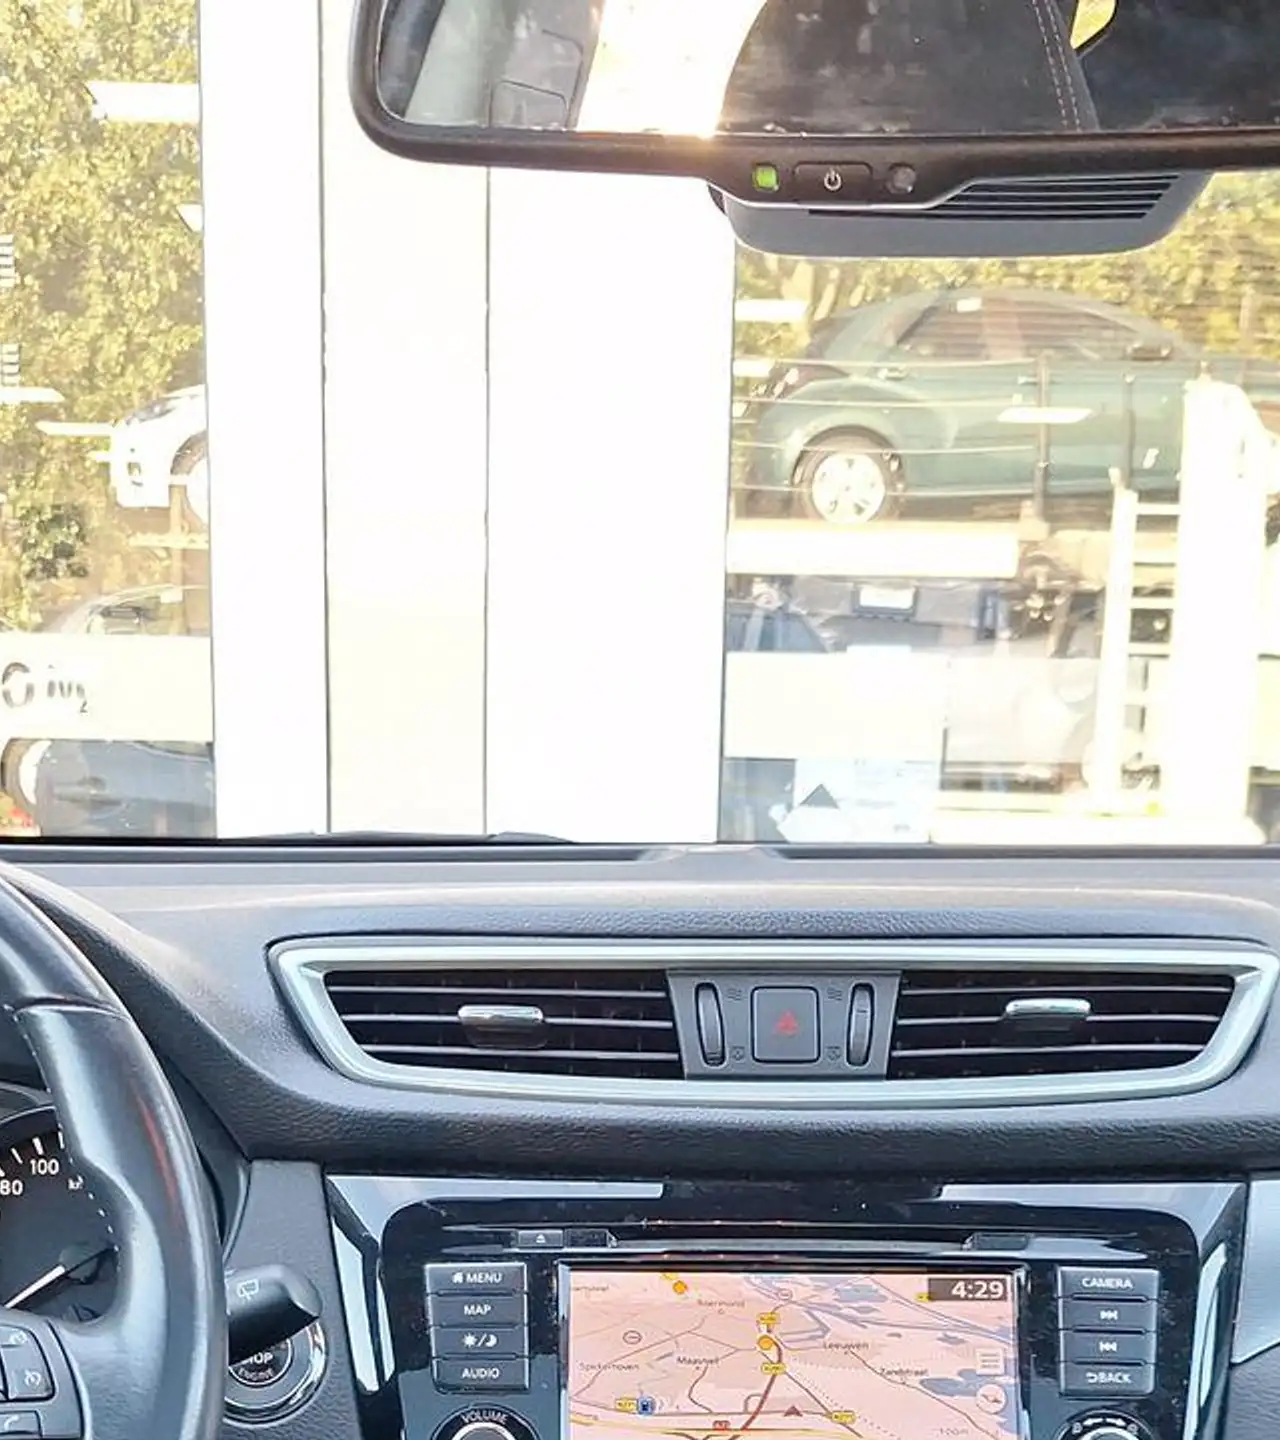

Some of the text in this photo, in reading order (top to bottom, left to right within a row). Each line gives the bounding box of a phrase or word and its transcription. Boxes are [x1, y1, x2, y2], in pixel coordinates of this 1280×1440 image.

[30, 1159, 60, 1176] 100
[0, 1180, 23, 1196] 80
[466, 1274, 503, 1284] MENU
[1082, 1278, 1134, 1290] CAMERA
[951, 1280, 1005, 1300] 4:29
[463, 1304, 492, 1316] MAP
[461, 1368, 500, 1379] AUDIO
[460, 1409, 509, 1425] VOLUME
